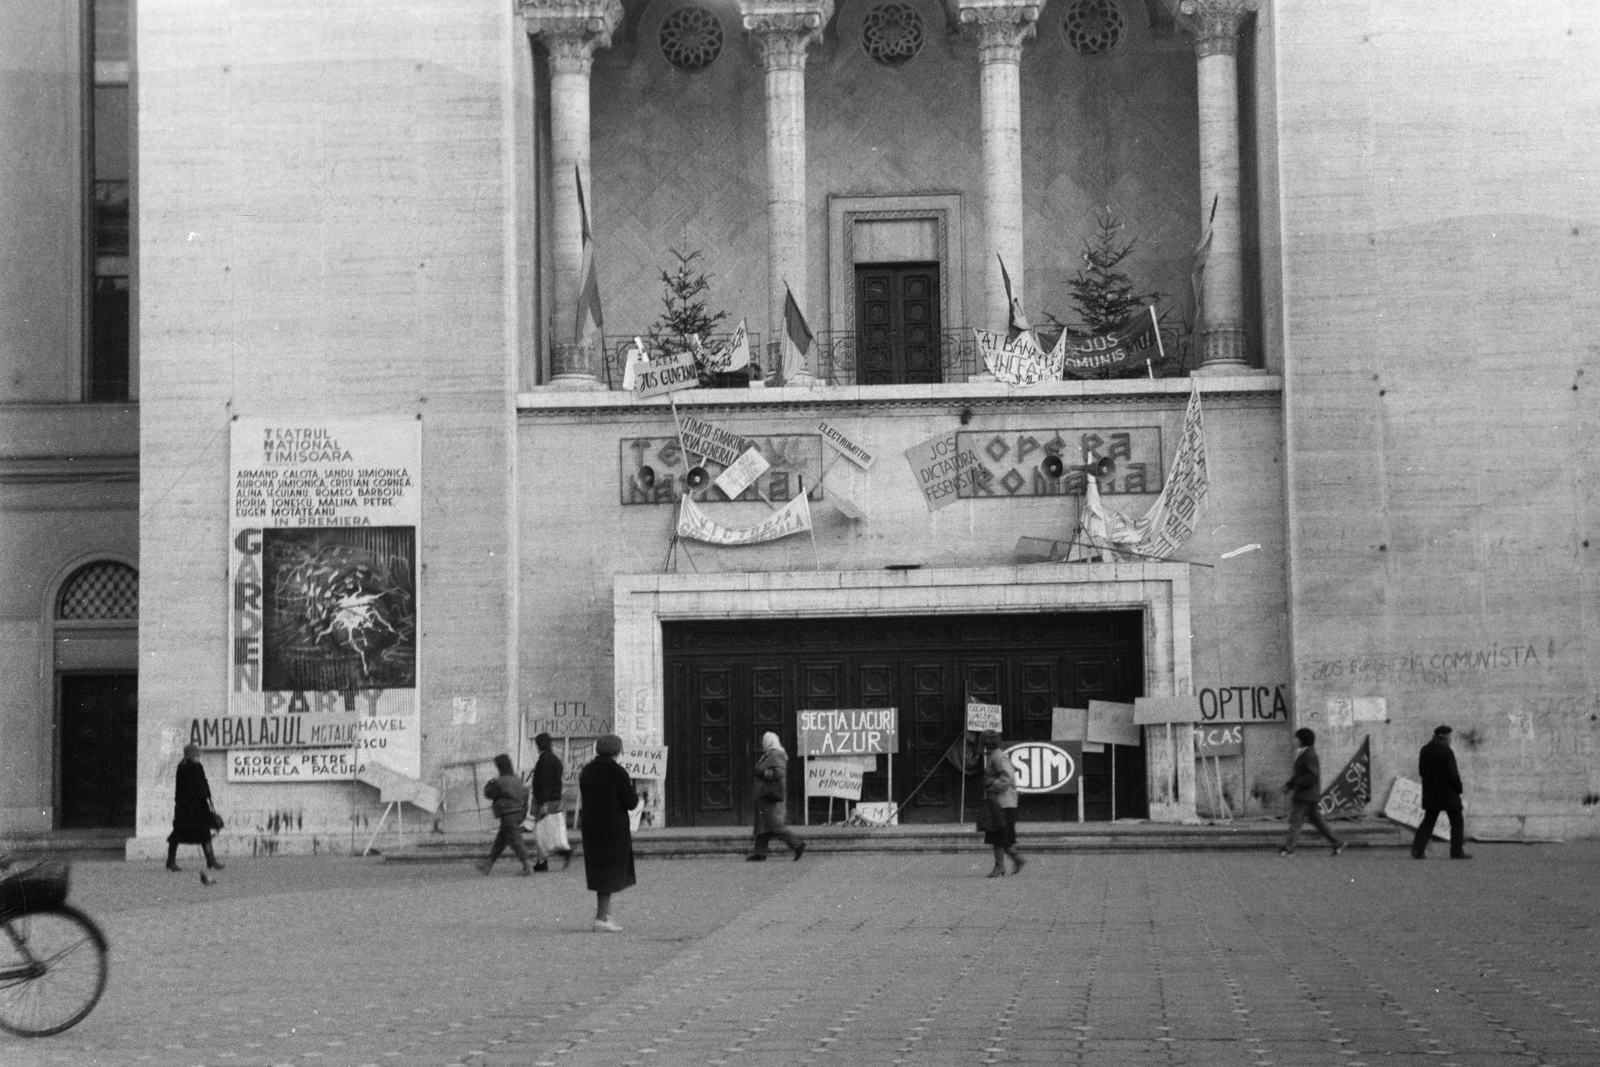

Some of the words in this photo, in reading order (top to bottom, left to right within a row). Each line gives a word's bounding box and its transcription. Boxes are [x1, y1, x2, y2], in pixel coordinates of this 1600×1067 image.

[264, 428, 330, 440] TEATRUL
[236, 469, 279, 479] ARMAND
[325, 468, 354, 478] SANDU
[236, 479, 274, 488] AURORA
[330, 478, 369, 488] CRISTIAN
[236, 488, 263, 498] ALINA
[315, 488, 353, 498] ROMEO
[236, 498, 267, 508] HORIA
[236, 508, 266, 518] EUGEN
[274, 517, 289, 528] IN
[298, 516, 372, 528] PREMIERA
[263, 688, 384, 719] PARTY
[358, 718, 407, 732] HAVEL
[190, 716, 305, 747] AMBALAJUL
[234, 755, 292, 766] GEORGE
[302, 754, 347, 766] PETRE
[234, 765, 300, 776] MIHAELA
[809, 768, 826, 778] NU
[1010, 747, 1067, 788] SIM
